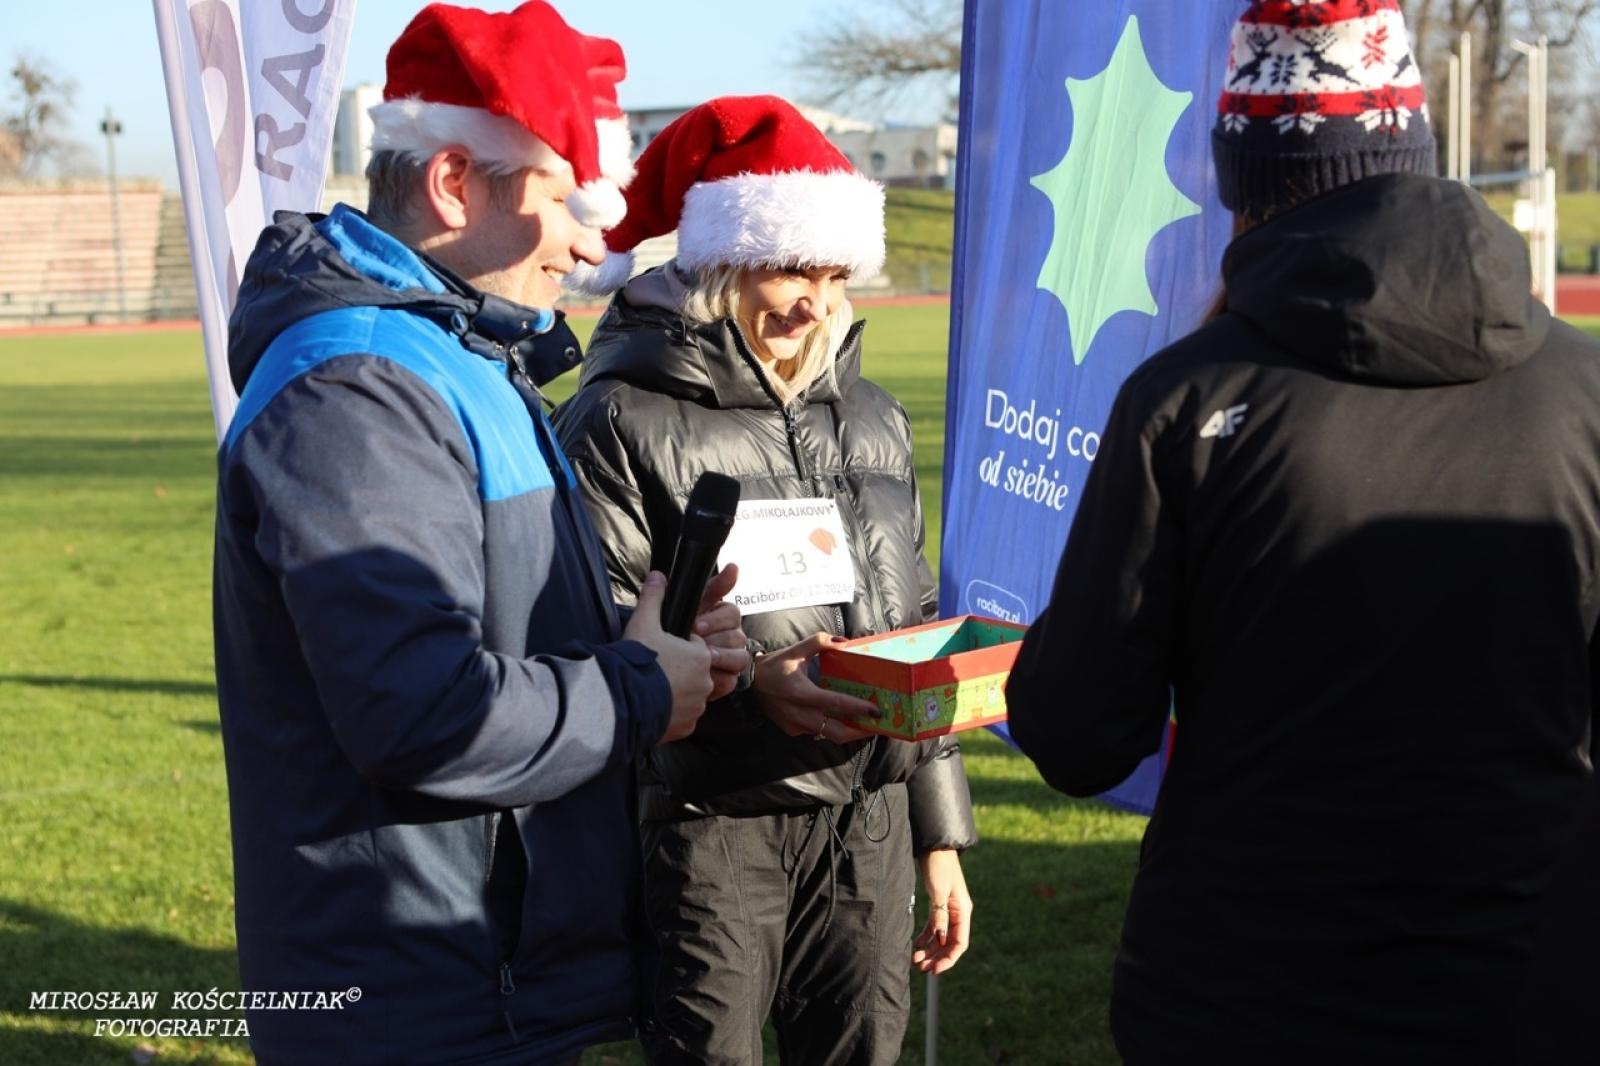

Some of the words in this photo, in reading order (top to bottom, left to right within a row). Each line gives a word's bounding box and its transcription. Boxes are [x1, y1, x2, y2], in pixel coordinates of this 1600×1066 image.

[985, 388, 1061, 460] Dodaj
[1066, 426, 1101, 462] co
[1199, 403, 1249, 438] 4F
[979, 450, 1005, 488] od
[1003, 458, 1069, 511] siebie
[752, 505, 832, 521] MIKOŁAJKOWY
[777, 551, 808, 576] 13
[734, 590, 786, 607] Racibórz
